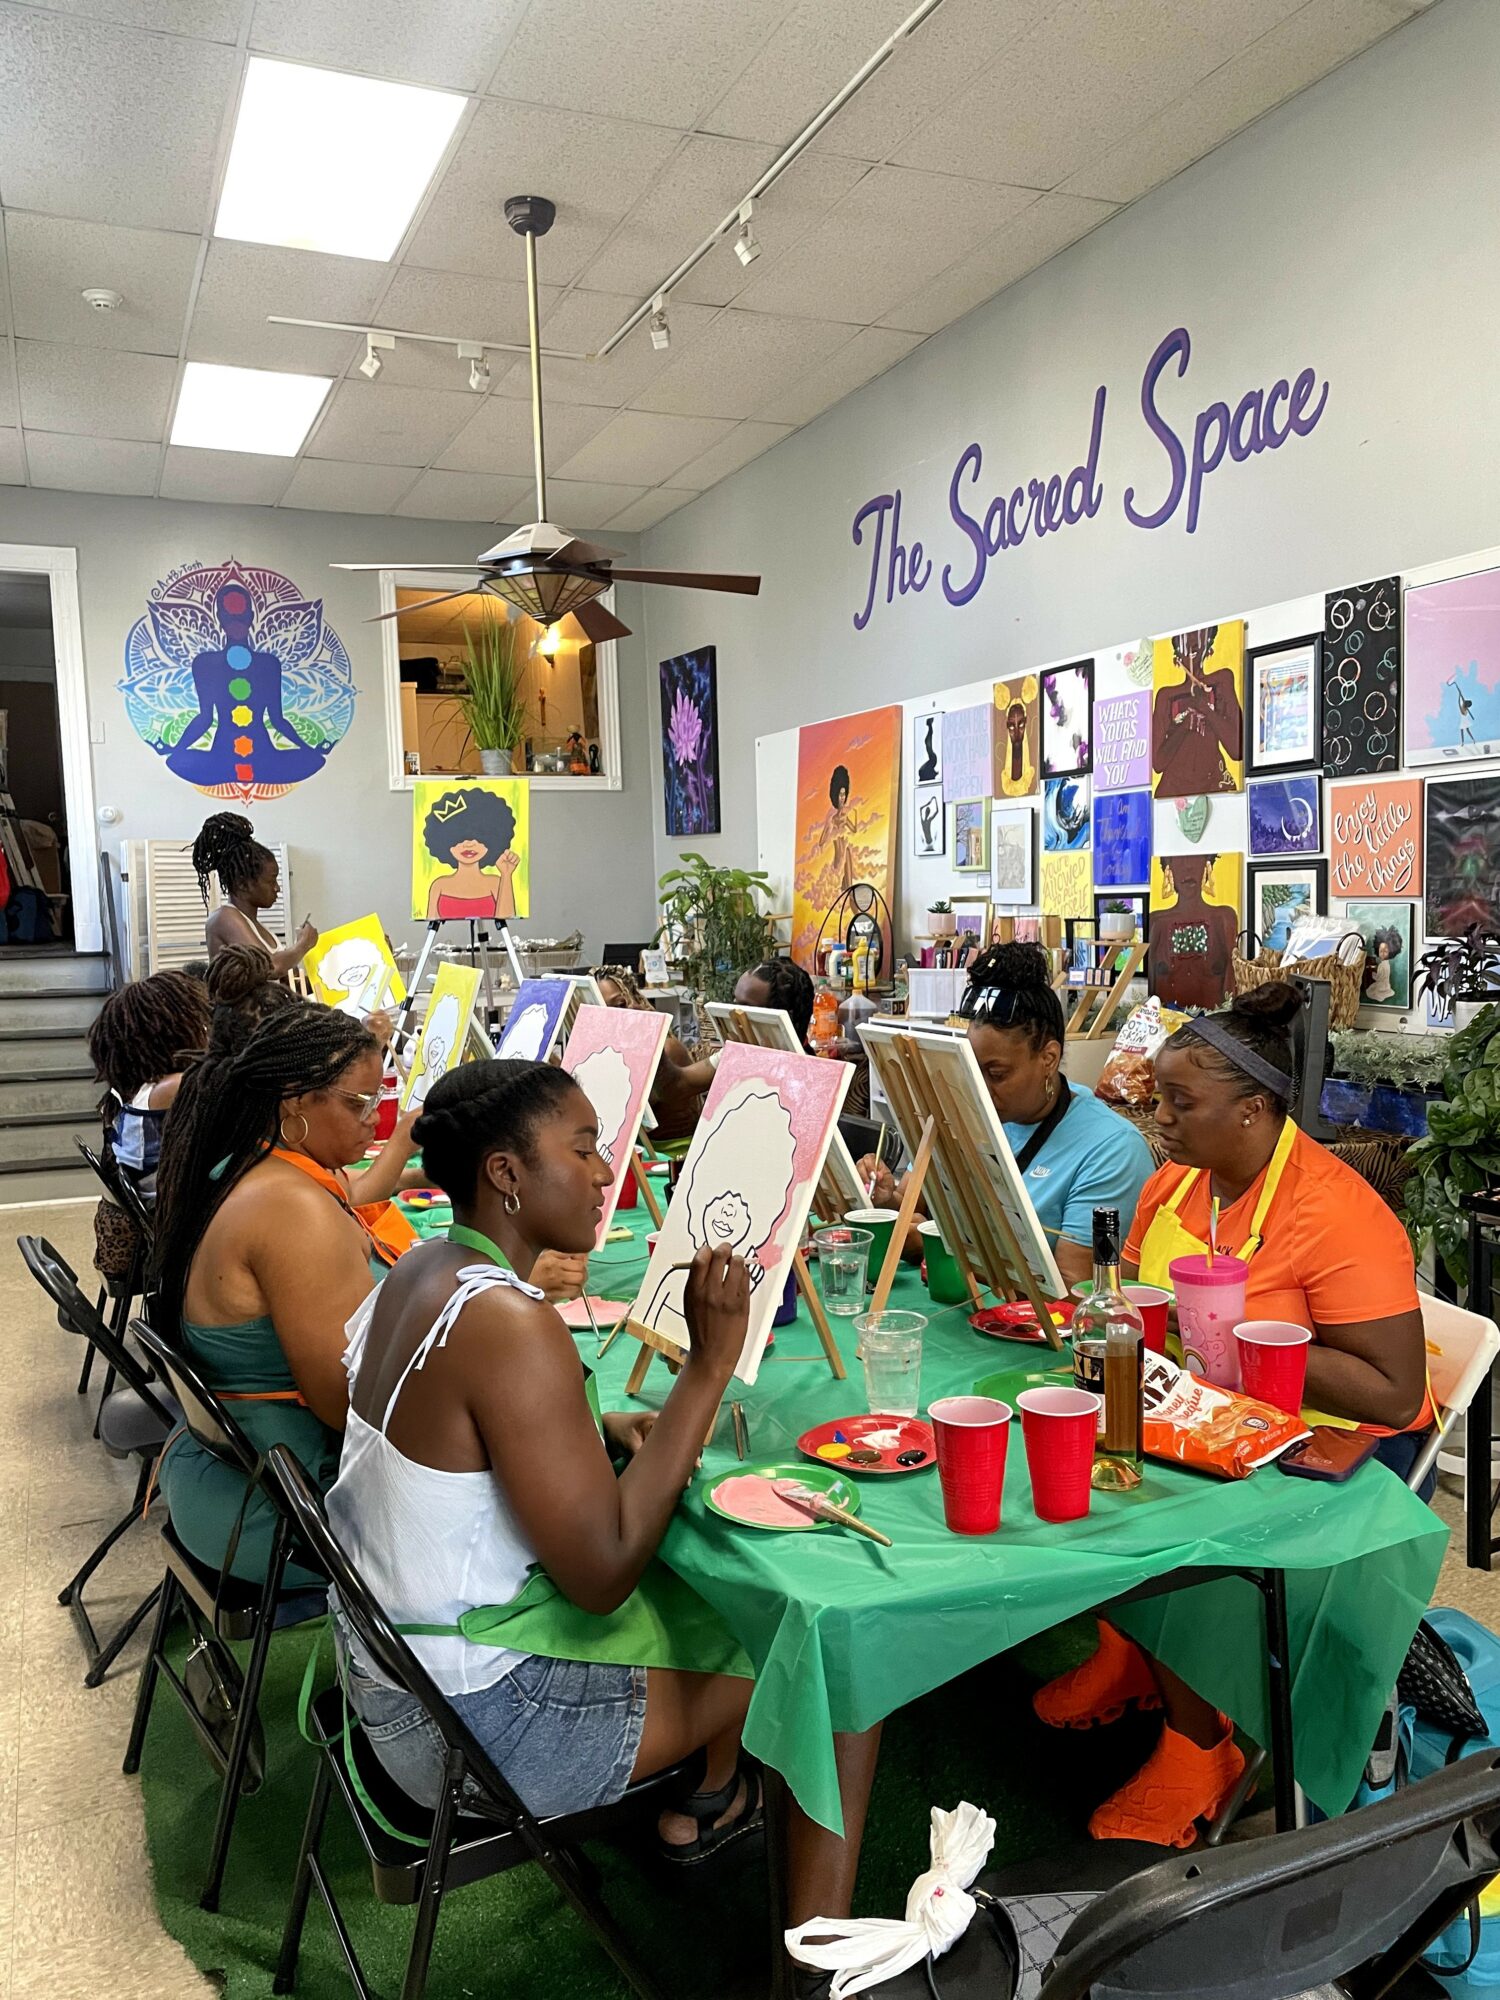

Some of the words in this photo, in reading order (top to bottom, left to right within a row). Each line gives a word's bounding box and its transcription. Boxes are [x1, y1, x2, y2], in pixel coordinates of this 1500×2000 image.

[852, 489, 932, 630] The
[942, 385, 1107, 606] Sacred
[1124, 327, 1329, 533] Space
[1100, 719, 1138, 744] YOURS
[1095, 744, 1118, 765] WILL
[1121, 739, 1147, 762] FIND
[1104, 763, 1130, 787] YOU
[1332, 851, 1366, 890] the
[1364, 800, 1412, 854] little
[1366, 838, 1416, 893] things
